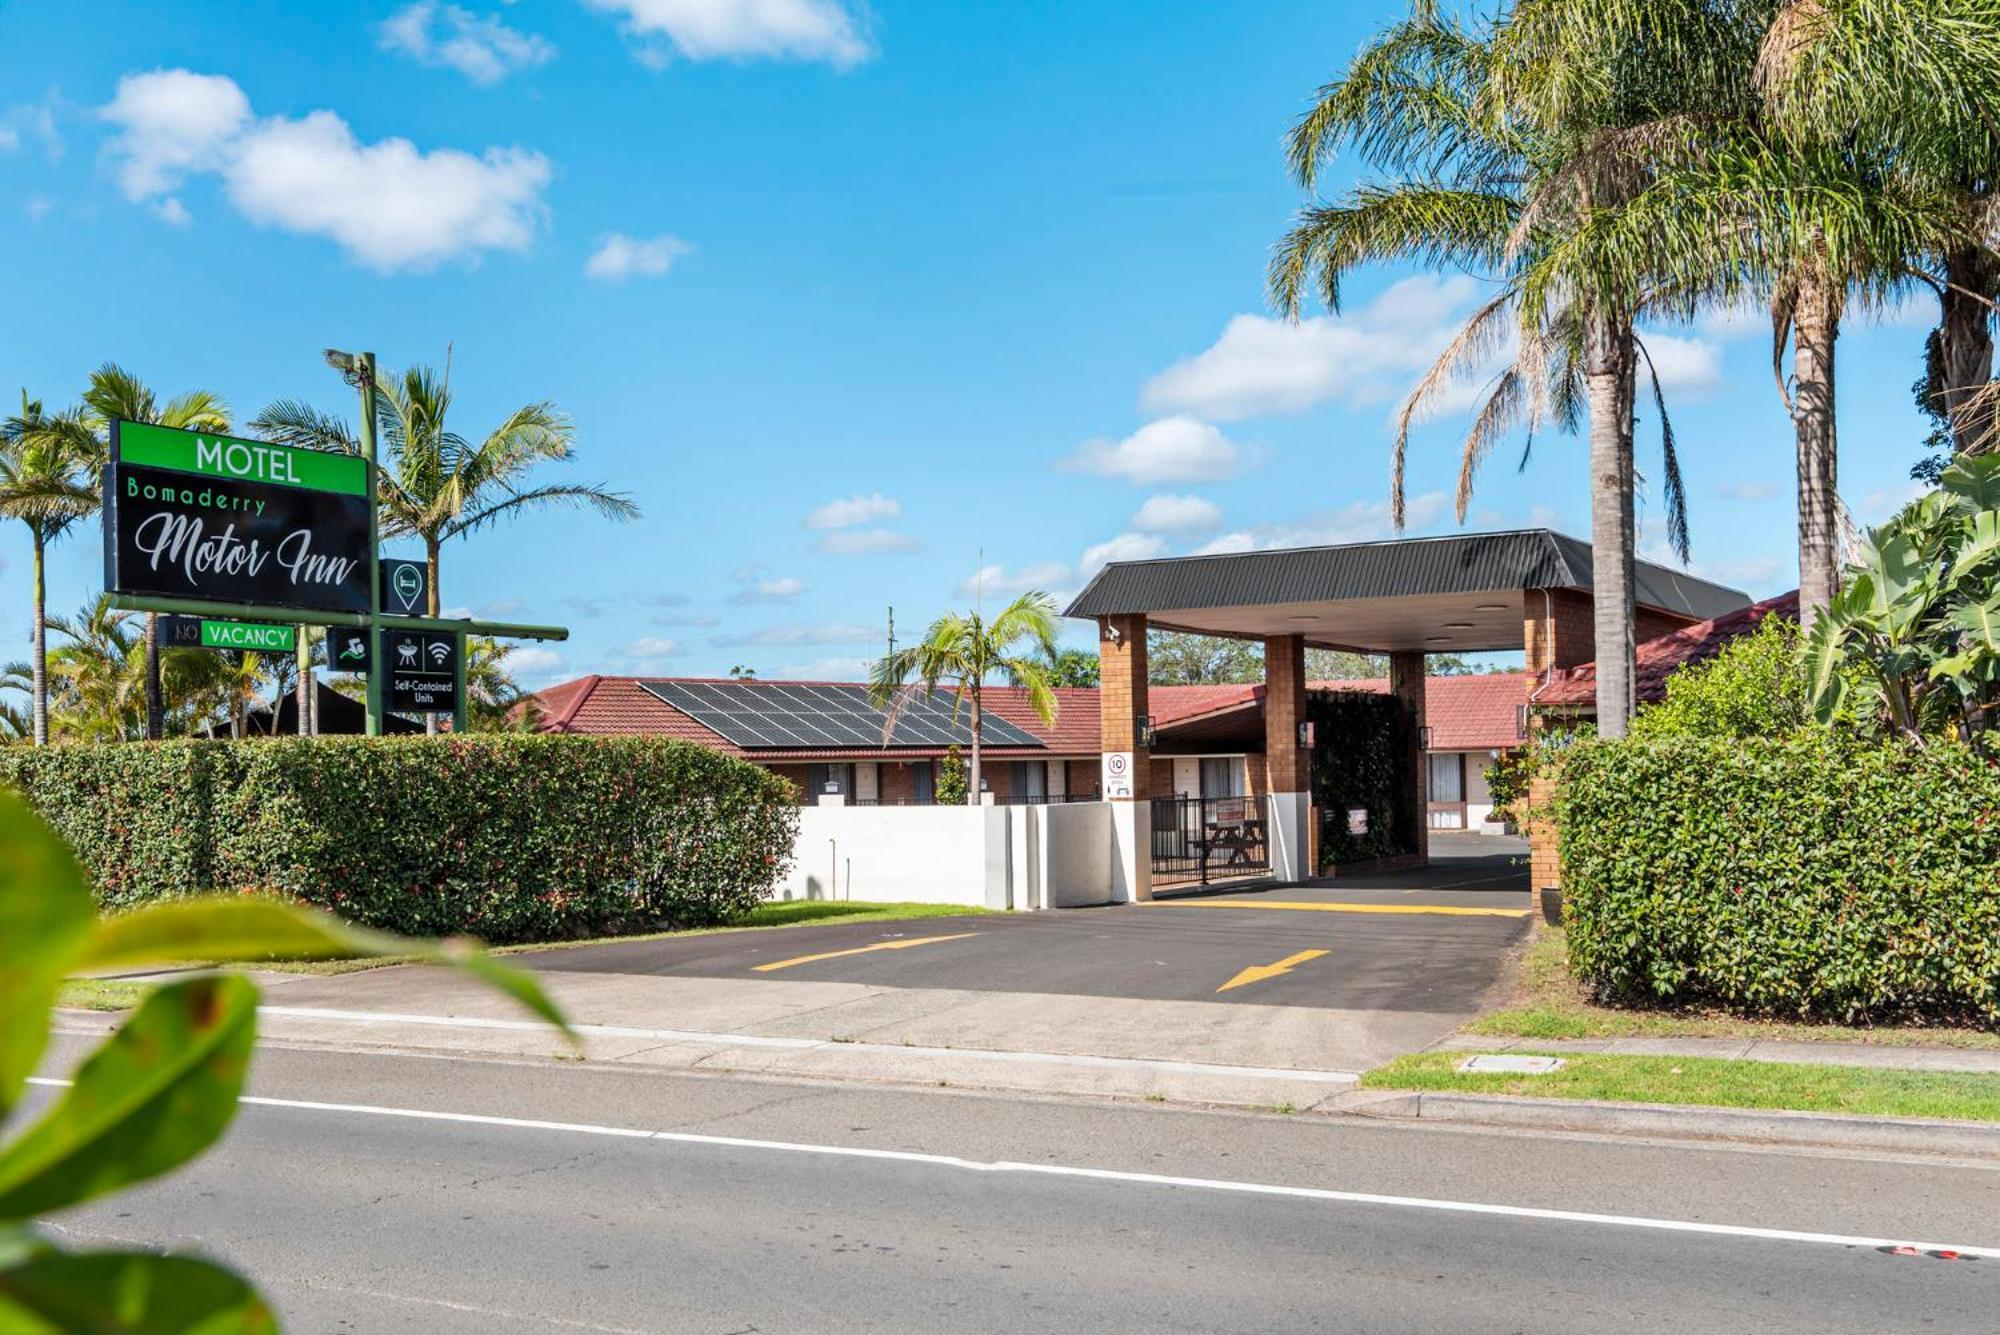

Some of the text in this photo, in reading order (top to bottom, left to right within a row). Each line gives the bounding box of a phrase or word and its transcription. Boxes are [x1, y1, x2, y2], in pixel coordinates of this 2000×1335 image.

[197, 438, 302, 483] MOTEL
[128, 477, 266, 516] Bomaderry
[135, 512, 357, 586] Motor Inn
[175, 624, 288, 646] NO VACANCY
[394, 679, 453, 692] Self-Contained
[415, 692, 434, 703] Units
[1112, 760, 1122, 769] 10
